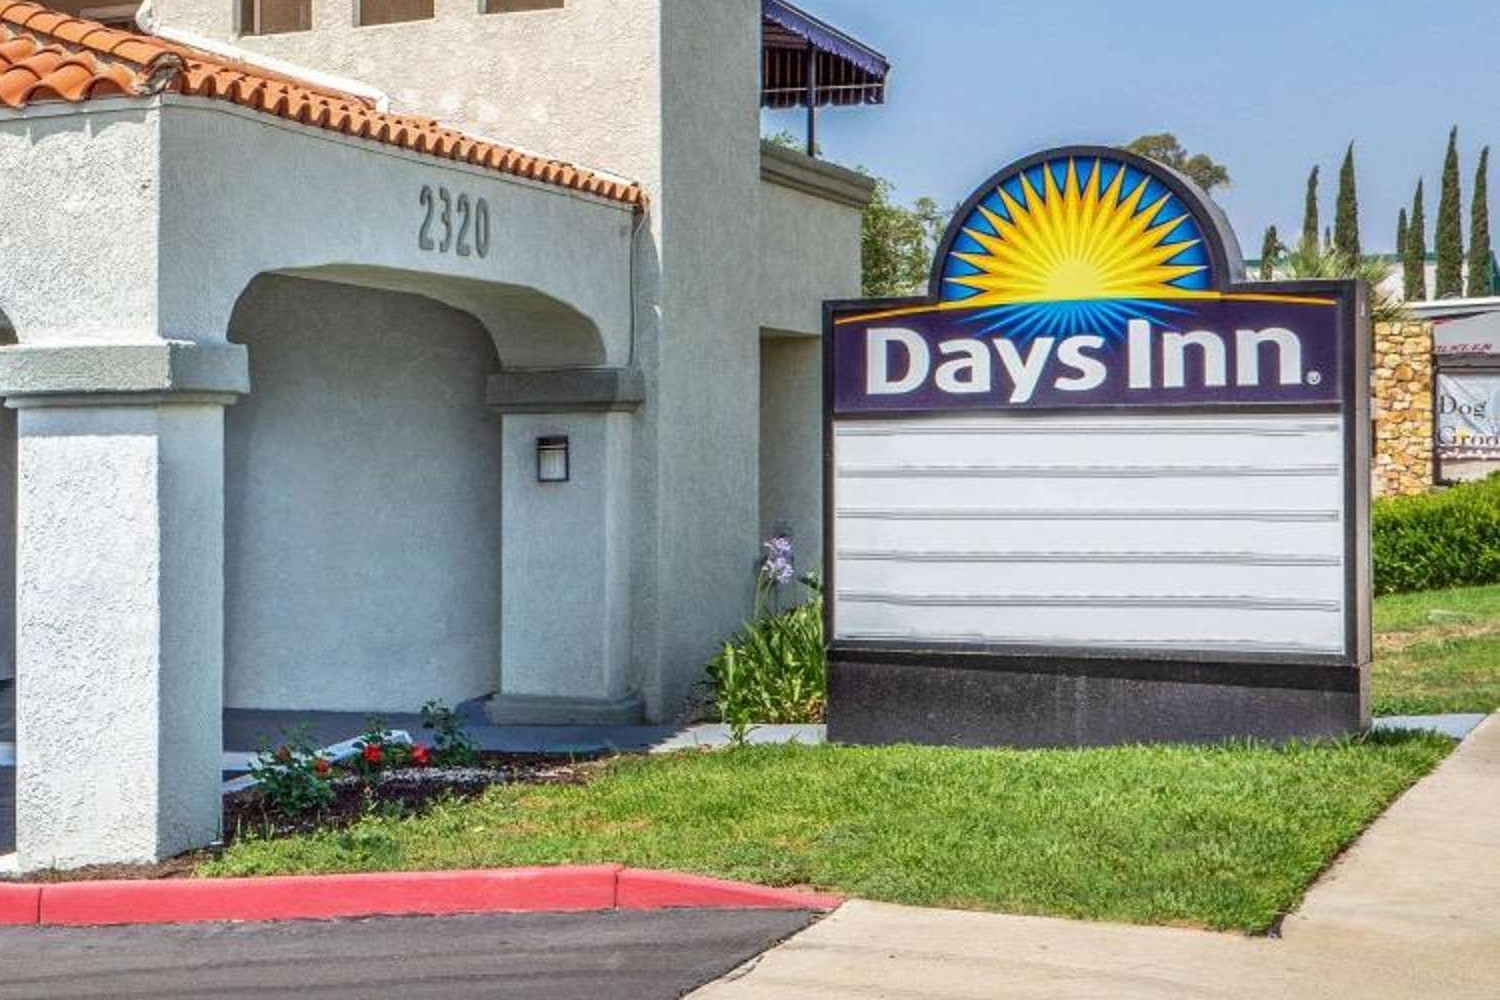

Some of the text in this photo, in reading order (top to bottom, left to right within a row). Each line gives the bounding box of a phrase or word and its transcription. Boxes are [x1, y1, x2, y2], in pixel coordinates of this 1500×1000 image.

[419, 184, 489, 258] 2320
[866, 327, 1108, 403] Days
[1440, 395, 1487, 420] Dog
